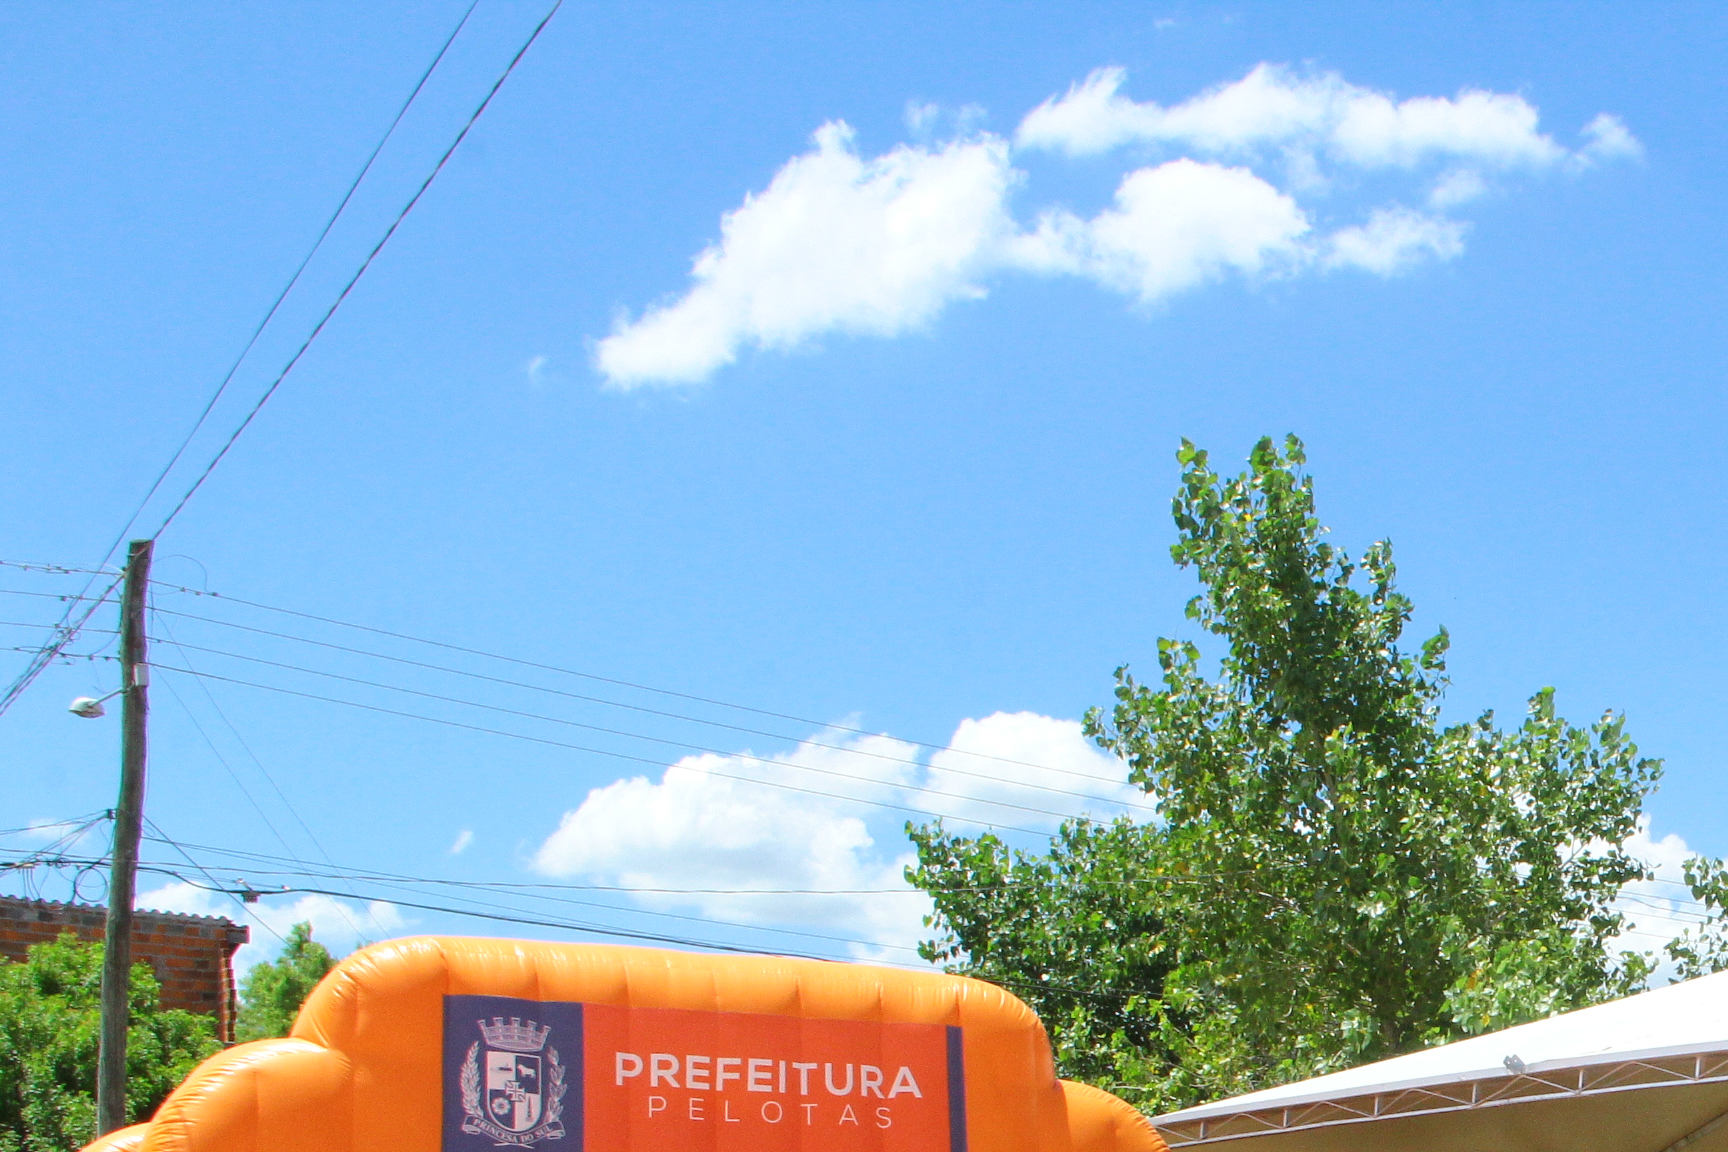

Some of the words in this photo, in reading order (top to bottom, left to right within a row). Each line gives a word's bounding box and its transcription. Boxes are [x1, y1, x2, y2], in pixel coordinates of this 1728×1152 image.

[615, 1051, 923, 1099] PREFEITURA
[648, 1096, 892, 1129] PELOTAS
[473, 1118, 519, 1143] PRINCESA
[521, 1133, 534, 1143] DO
[536, 1125, 552, 1138] SUL
